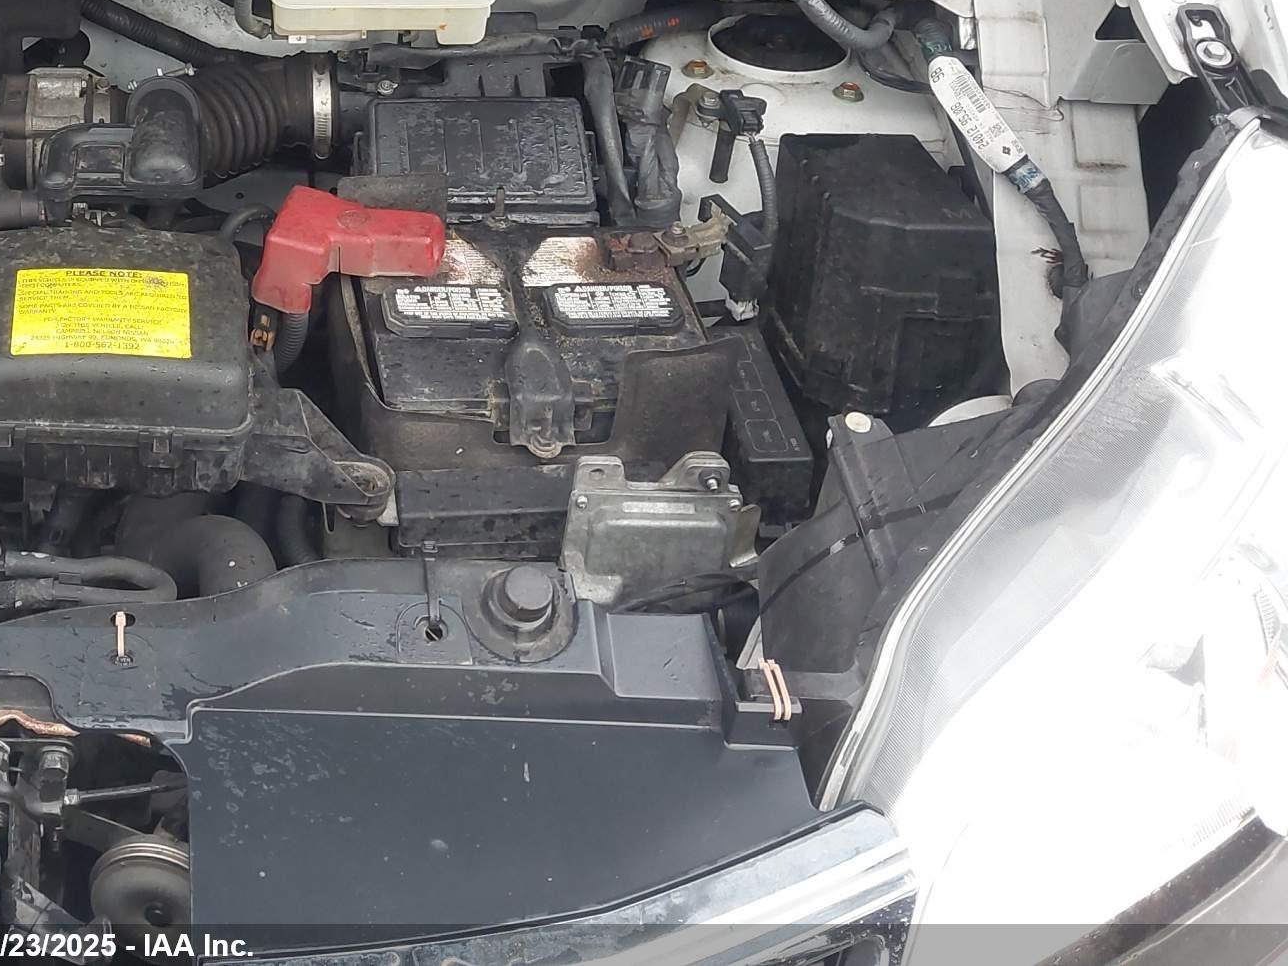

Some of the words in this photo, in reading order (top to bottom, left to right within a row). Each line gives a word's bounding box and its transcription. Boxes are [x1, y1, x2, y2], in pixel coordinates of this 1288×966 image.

[966, 124, 990, 150] 24012
[109, 271, 143, 279] NOTE:
[65, 341, 140, 350] 1-800-562-1392
